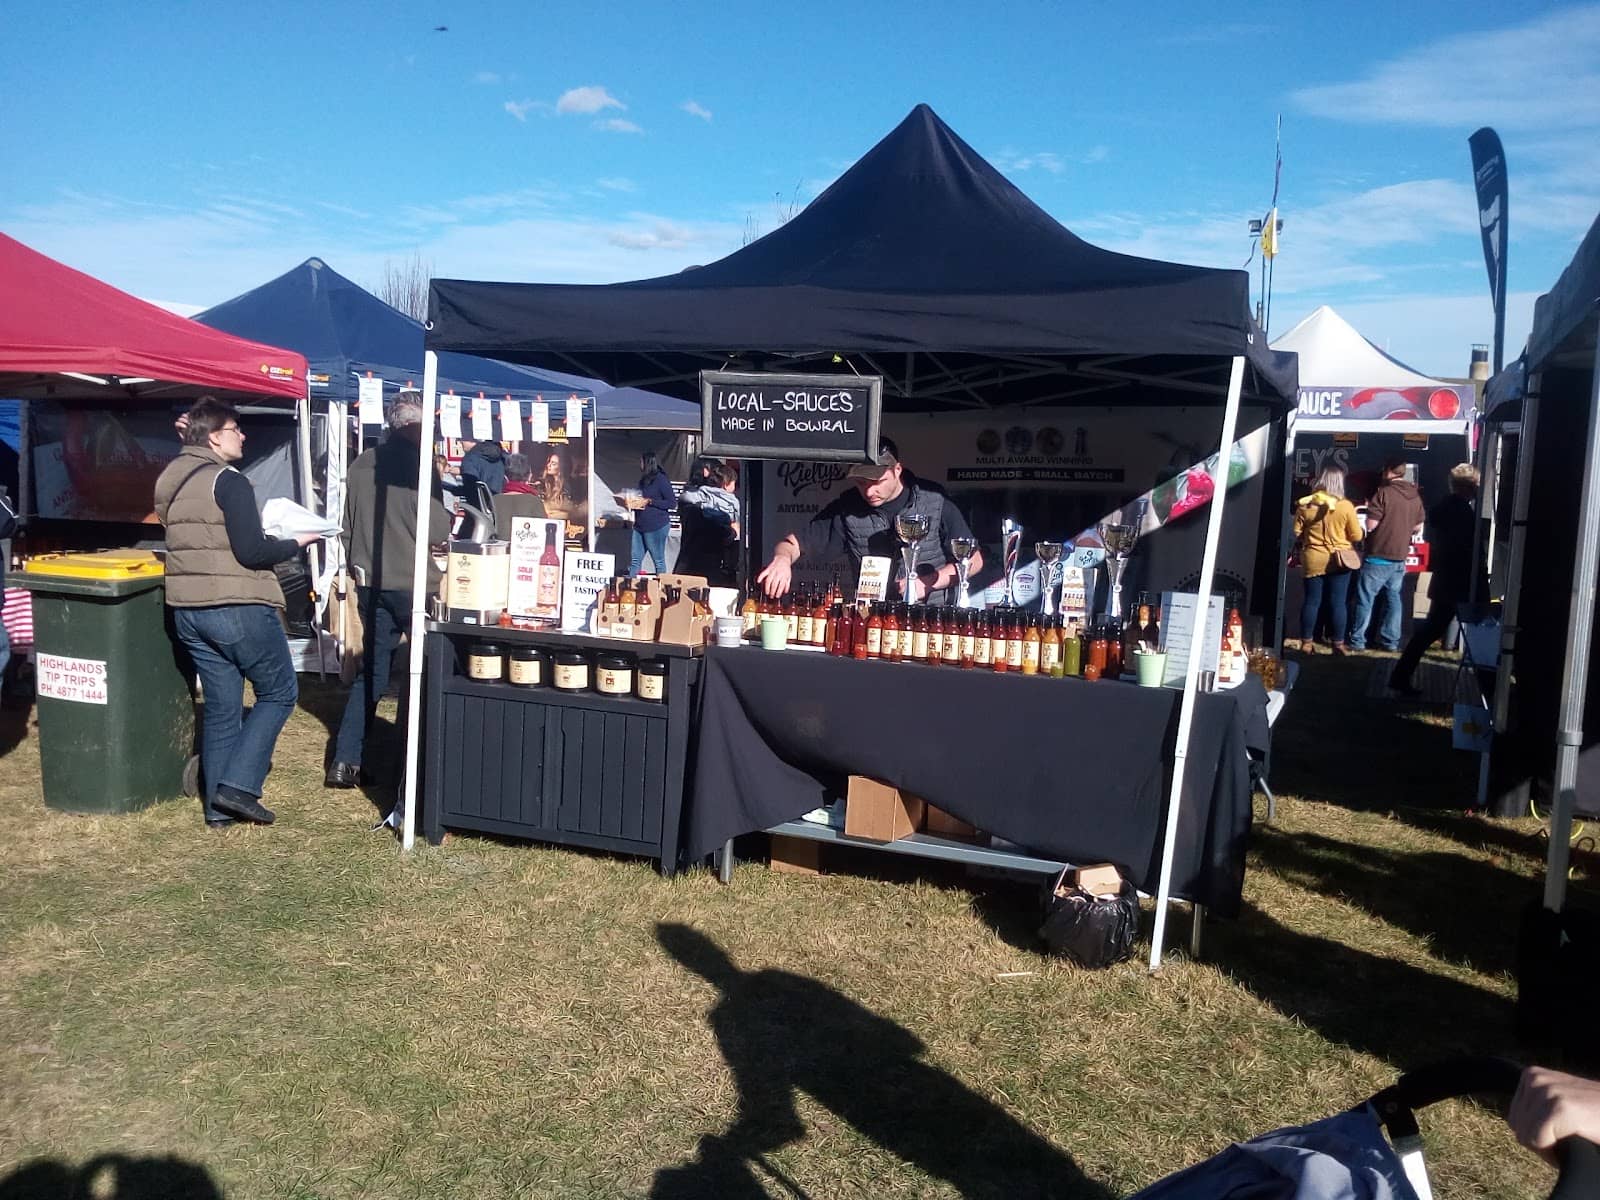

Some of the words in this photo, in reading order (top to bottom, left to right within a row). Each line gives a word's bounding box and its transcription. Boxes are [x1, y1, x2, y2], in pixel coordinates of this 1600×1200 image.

[1297, 391, 1342, 416] AUCE
[721, 417, 756, 431] MADE
[763, 418, 775, 431] IN
[786, 419, 855, 433] BOWRAL
[976, 456, 1005, 465] MULTI
[1008, 456, 1043, 465] AWARD
[1047, 456, 1093, 466] WINNING
[1296, 447, 1349, 478] EY'S
[957, 471, 987, 480] HAND
[991, 471, 1023, 480] MADE
[1033, 471, 1071, 480] SMALL
[1074, 472, 1113, 481] BATCH
[776, 503, 819, 513] ARTISAN
[577, 558, 605, 571] FREE
[571, 574, 583, 583] PIE
[585, 576, 609, 585] SAUCE
[574, 586, 598, 596] TASTI
[40, 657, 103, 675] HIGHLANDS
[46, 671, 61, 683] TIP
[63, 674, 96, 688] TRIPS
[57, 686, 77, 697] 4877
